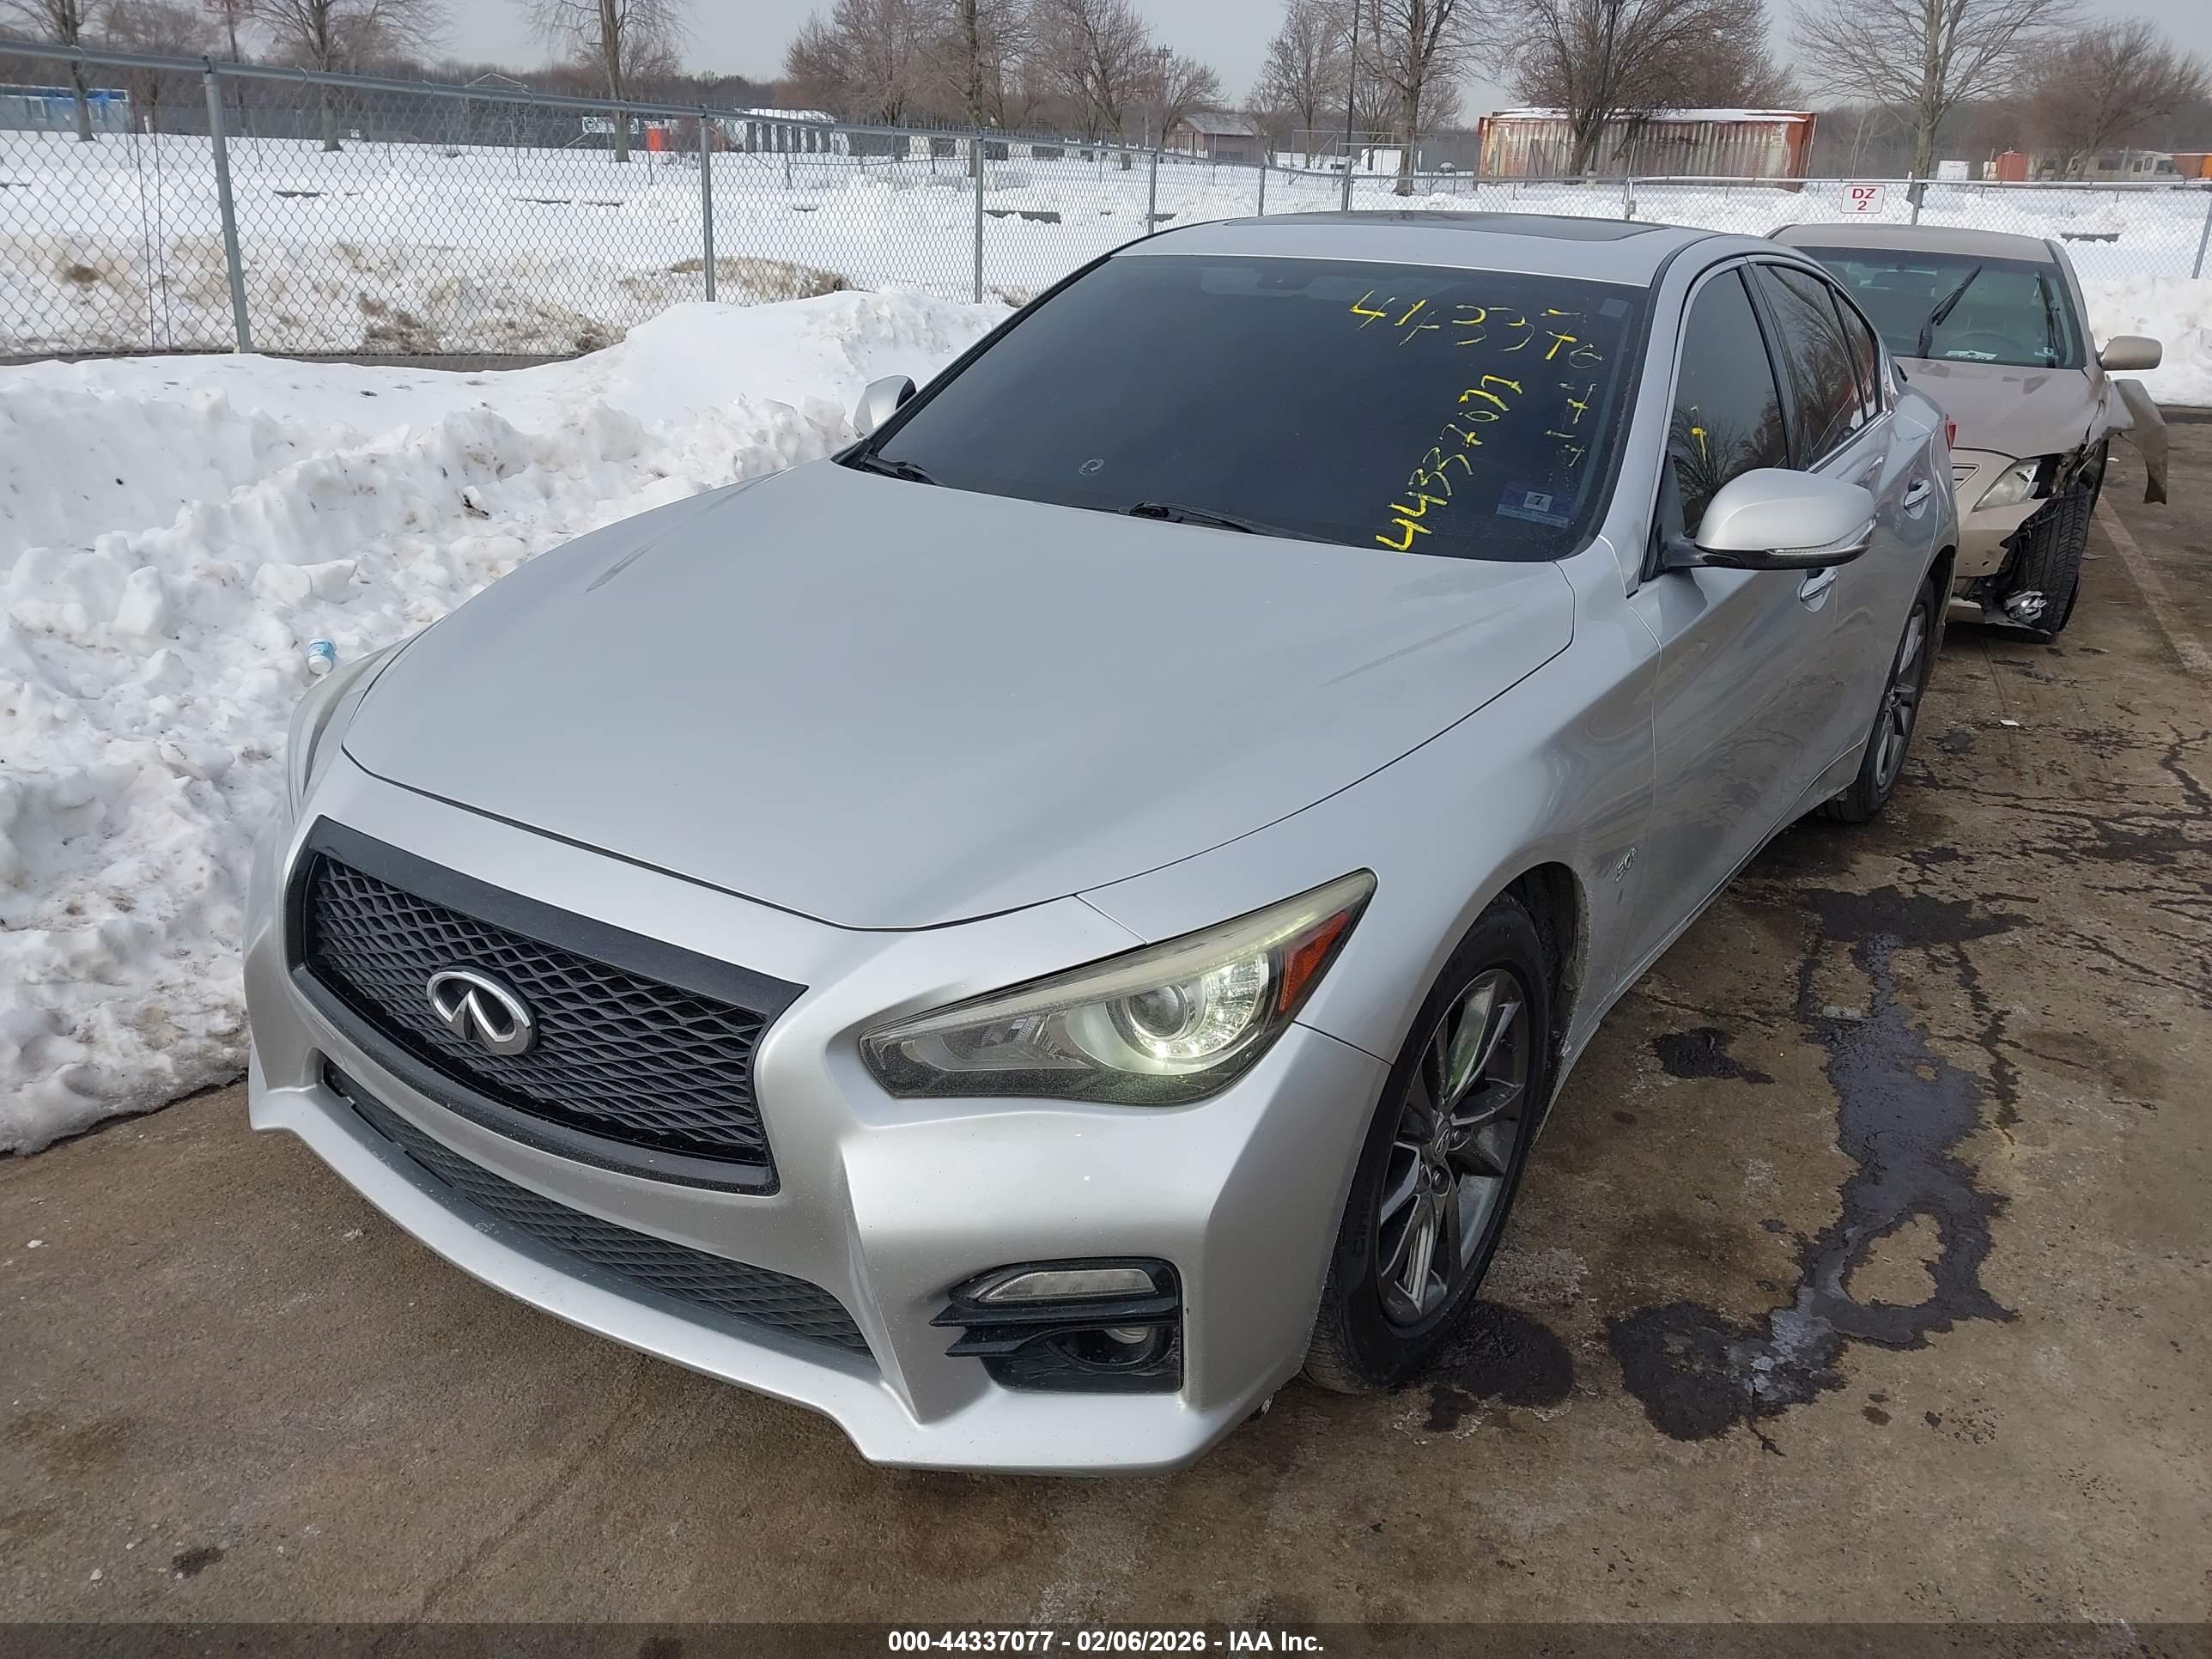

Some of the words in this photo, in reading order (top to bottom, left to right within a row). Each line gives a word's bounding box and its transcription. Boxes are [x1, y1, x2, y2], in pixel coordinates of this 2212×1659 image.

[1852, 188, 1877, 198] DZ
[1856, 200, 1867, 210] 2
[1375, 374, 1524, 551] 44337077
[1534, 495, 1544, 506] 7
